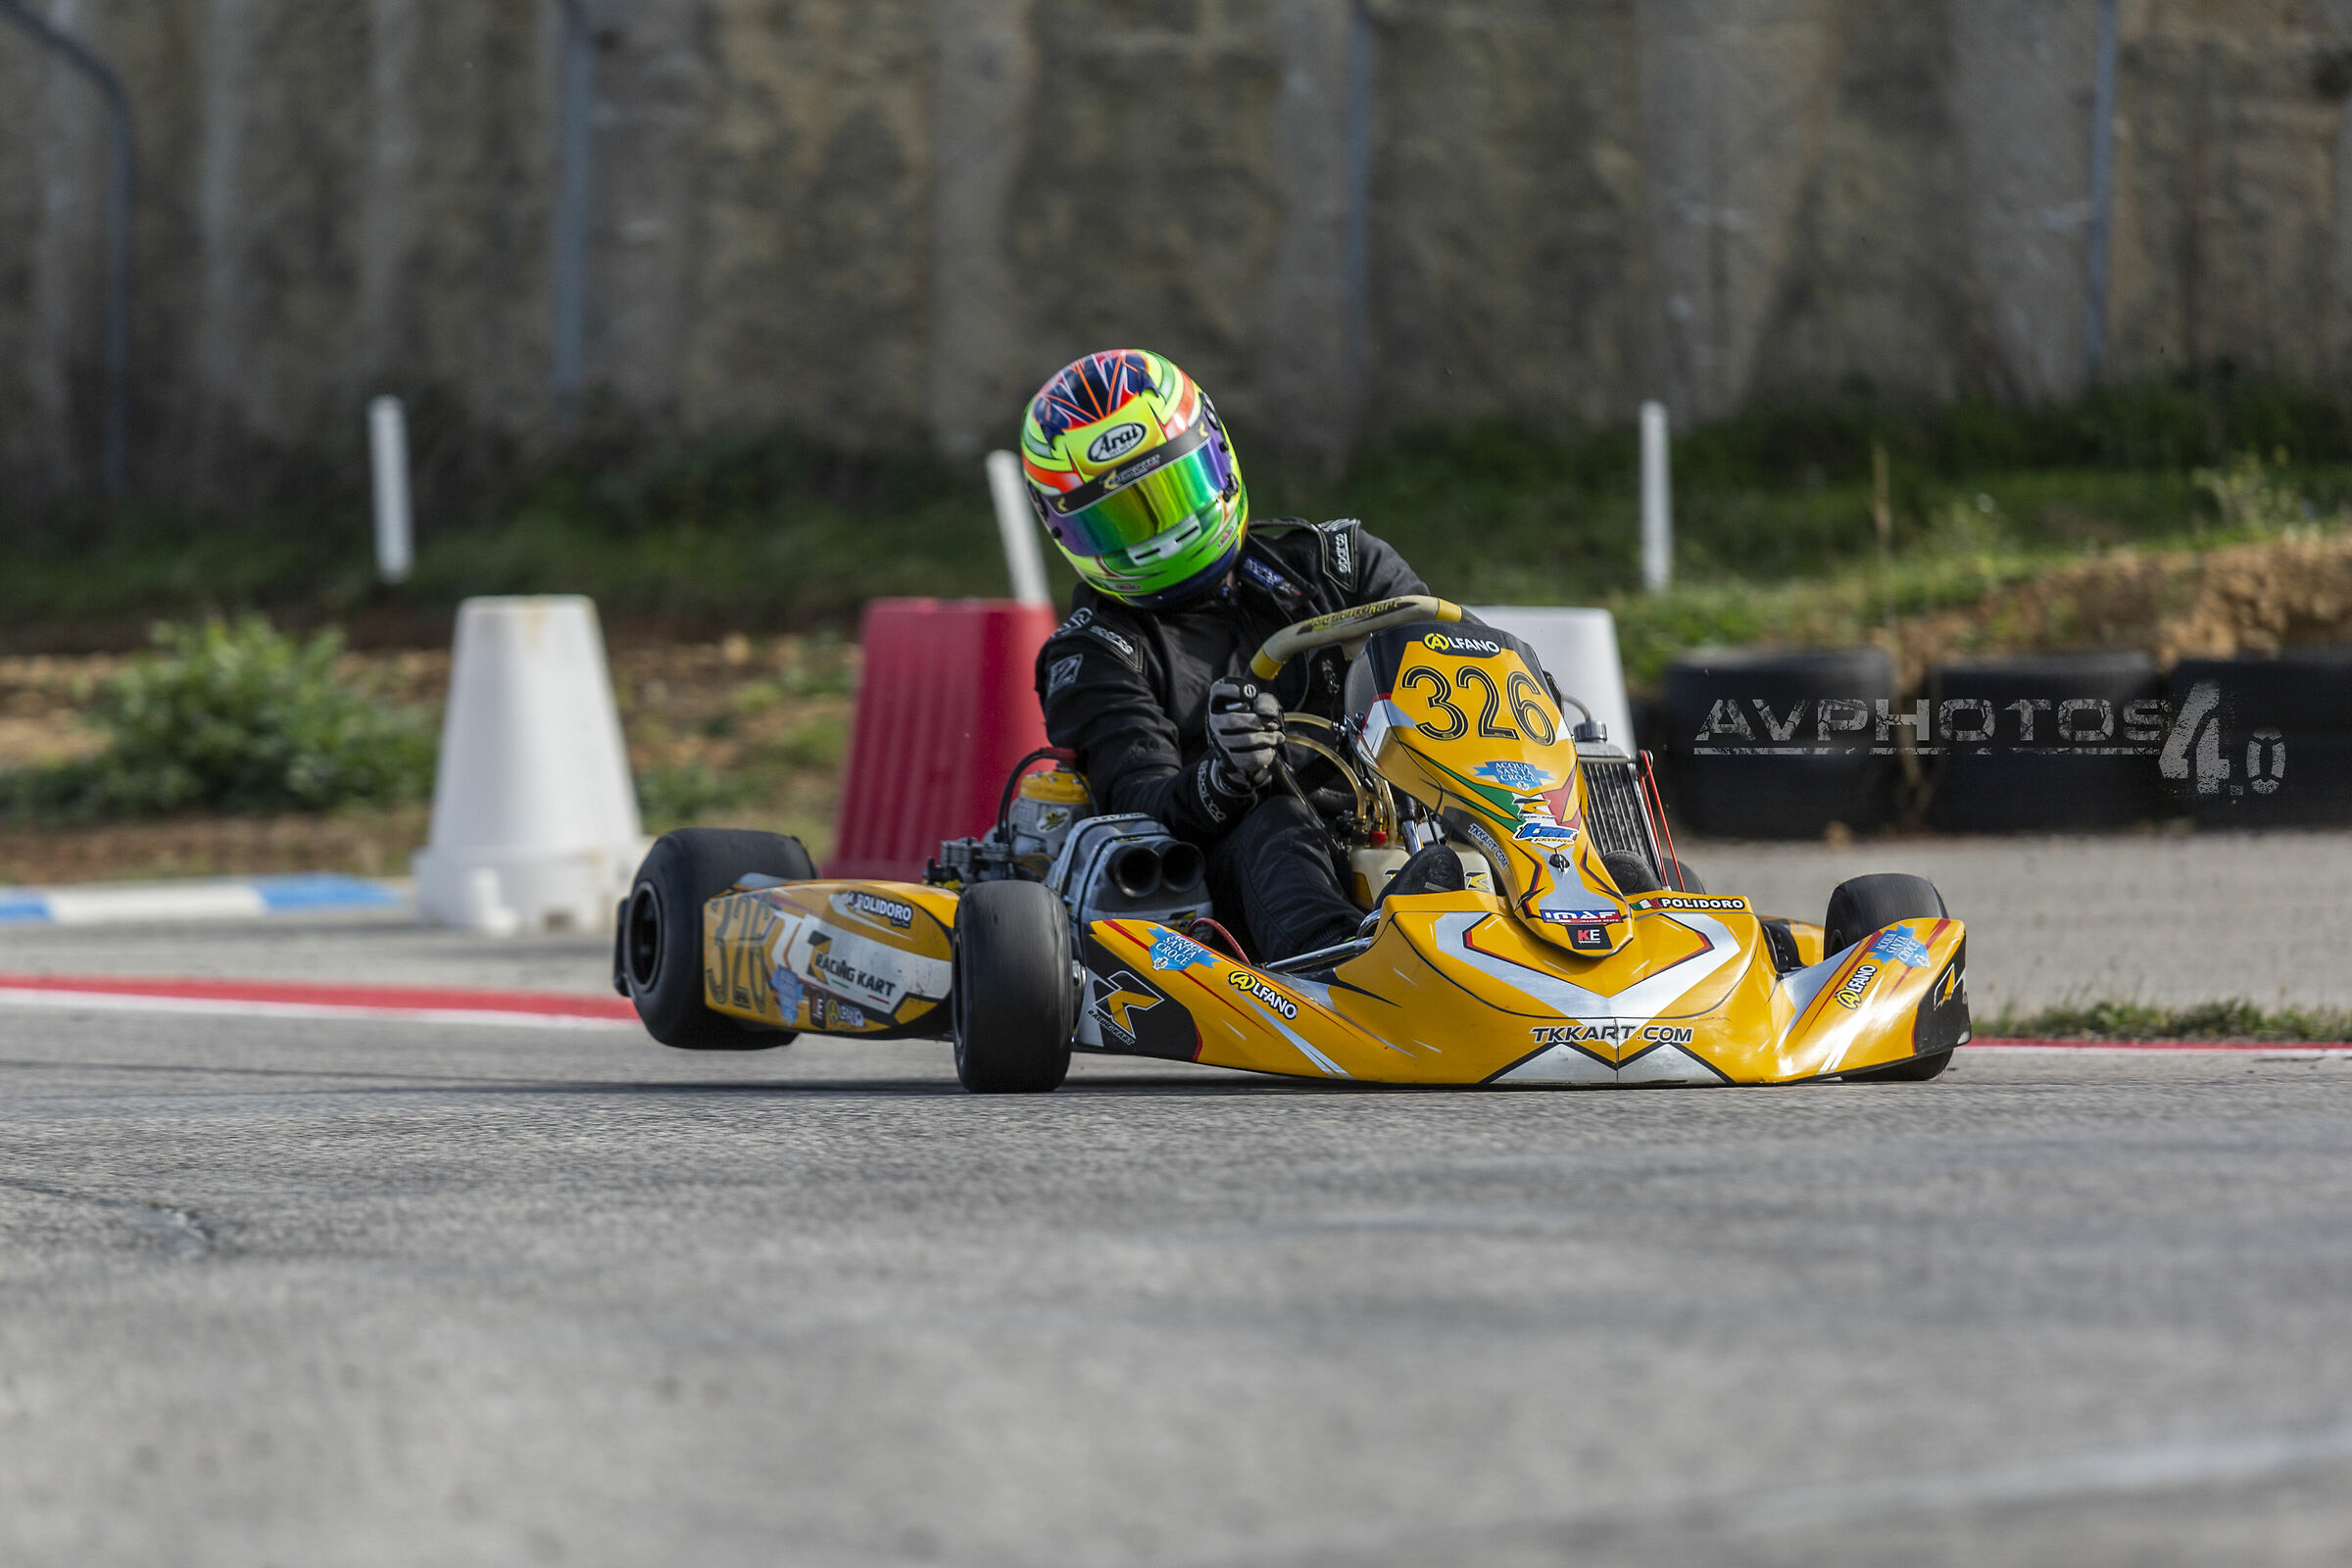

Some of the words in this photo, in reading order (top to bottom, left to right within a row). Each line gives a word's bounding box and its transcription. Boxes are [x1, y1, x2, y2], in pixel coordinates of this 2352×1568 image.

[1095, 423, 1138, 459] Arai
[1424, 632, 1500, 654] ALFANO
[1400, 664, 1555, 747] 326
[1495, 761, 1531, 771] ACQUA
[1497, 768, 1534, 778] SANTA
[1500, 773, 1536, 783] CROCE
[1660, 898, 1744, 909] POLIDORO
[1577, 929, 1601, 942] KE
[1156, 942, 1191, 966] CROCE
[1163, 936, 1197, 958] SANTA
[857, 970, 896, 997] KART
[1229, 970, 1298, 1019] ALFANO
[1838, 964, 1878, 1009] ALFANO
[1531, 1026, 1693, 1043] TKKART.COM
